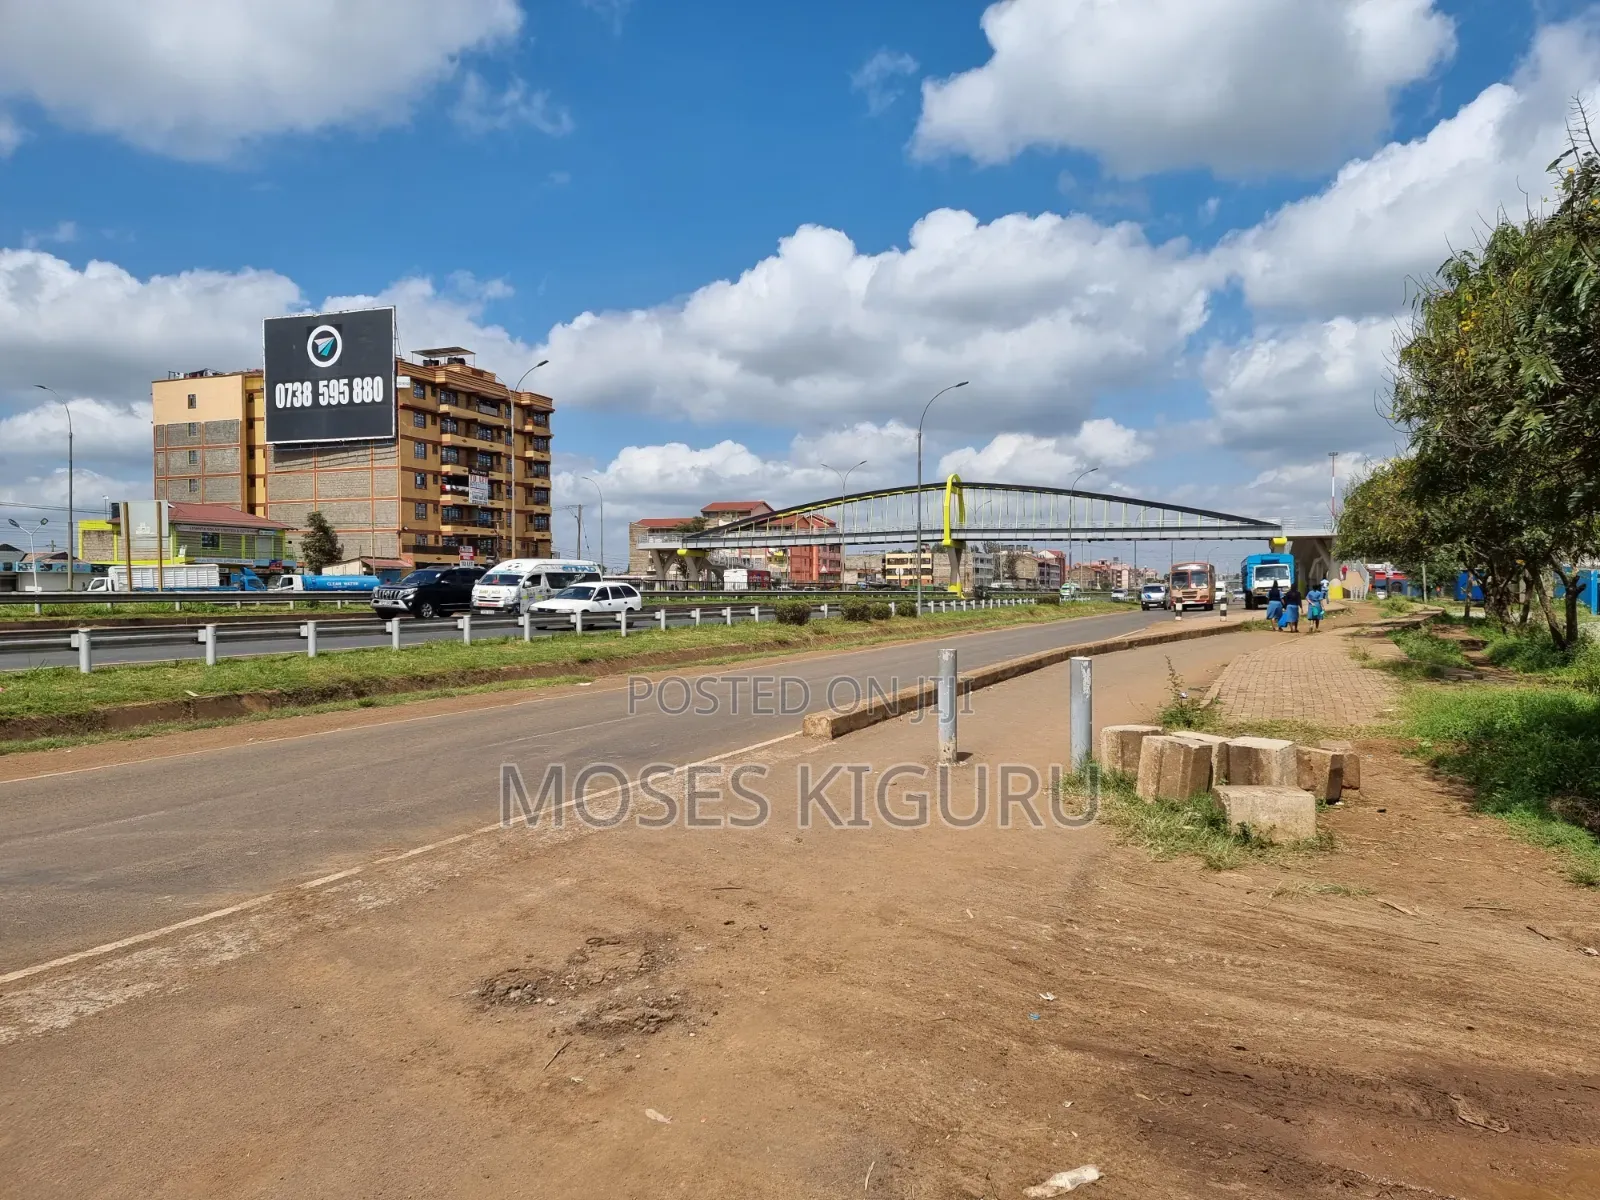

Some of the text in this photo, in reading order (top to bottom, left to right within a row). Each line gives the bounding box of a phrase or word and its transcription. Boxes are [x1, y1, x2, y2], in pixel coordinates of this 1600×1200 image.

[275, 376, 384, 408] 0738 595 880
